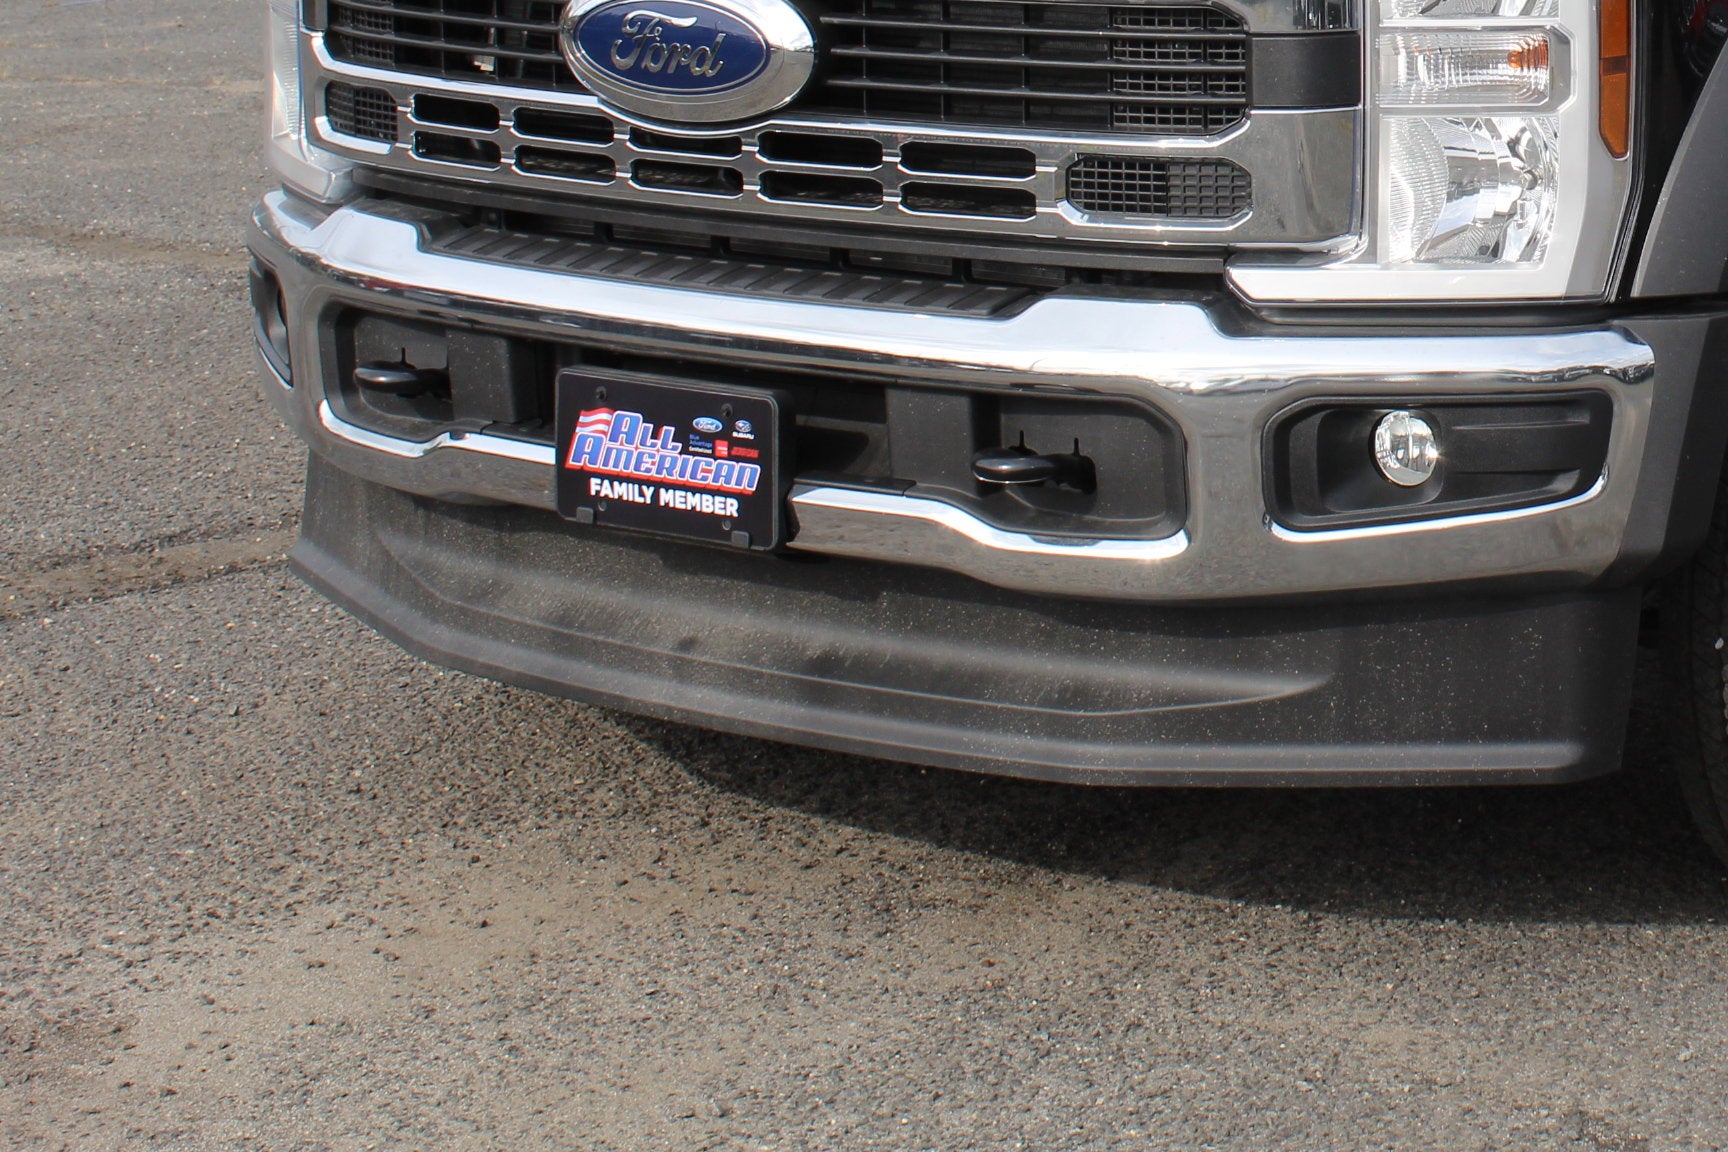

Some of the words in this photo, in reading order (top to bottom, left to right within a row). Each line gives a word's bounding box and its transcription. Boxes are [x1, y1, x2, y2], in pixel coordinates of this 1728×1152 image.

[611, 9, 726, 78] Ford
[607, 410, 682, 454] ALL
[567, 432, 761, 494] AMERICAN
[590, 477, 655, 505] FAMILY
[659, 488, 739, 518] MEMBER
